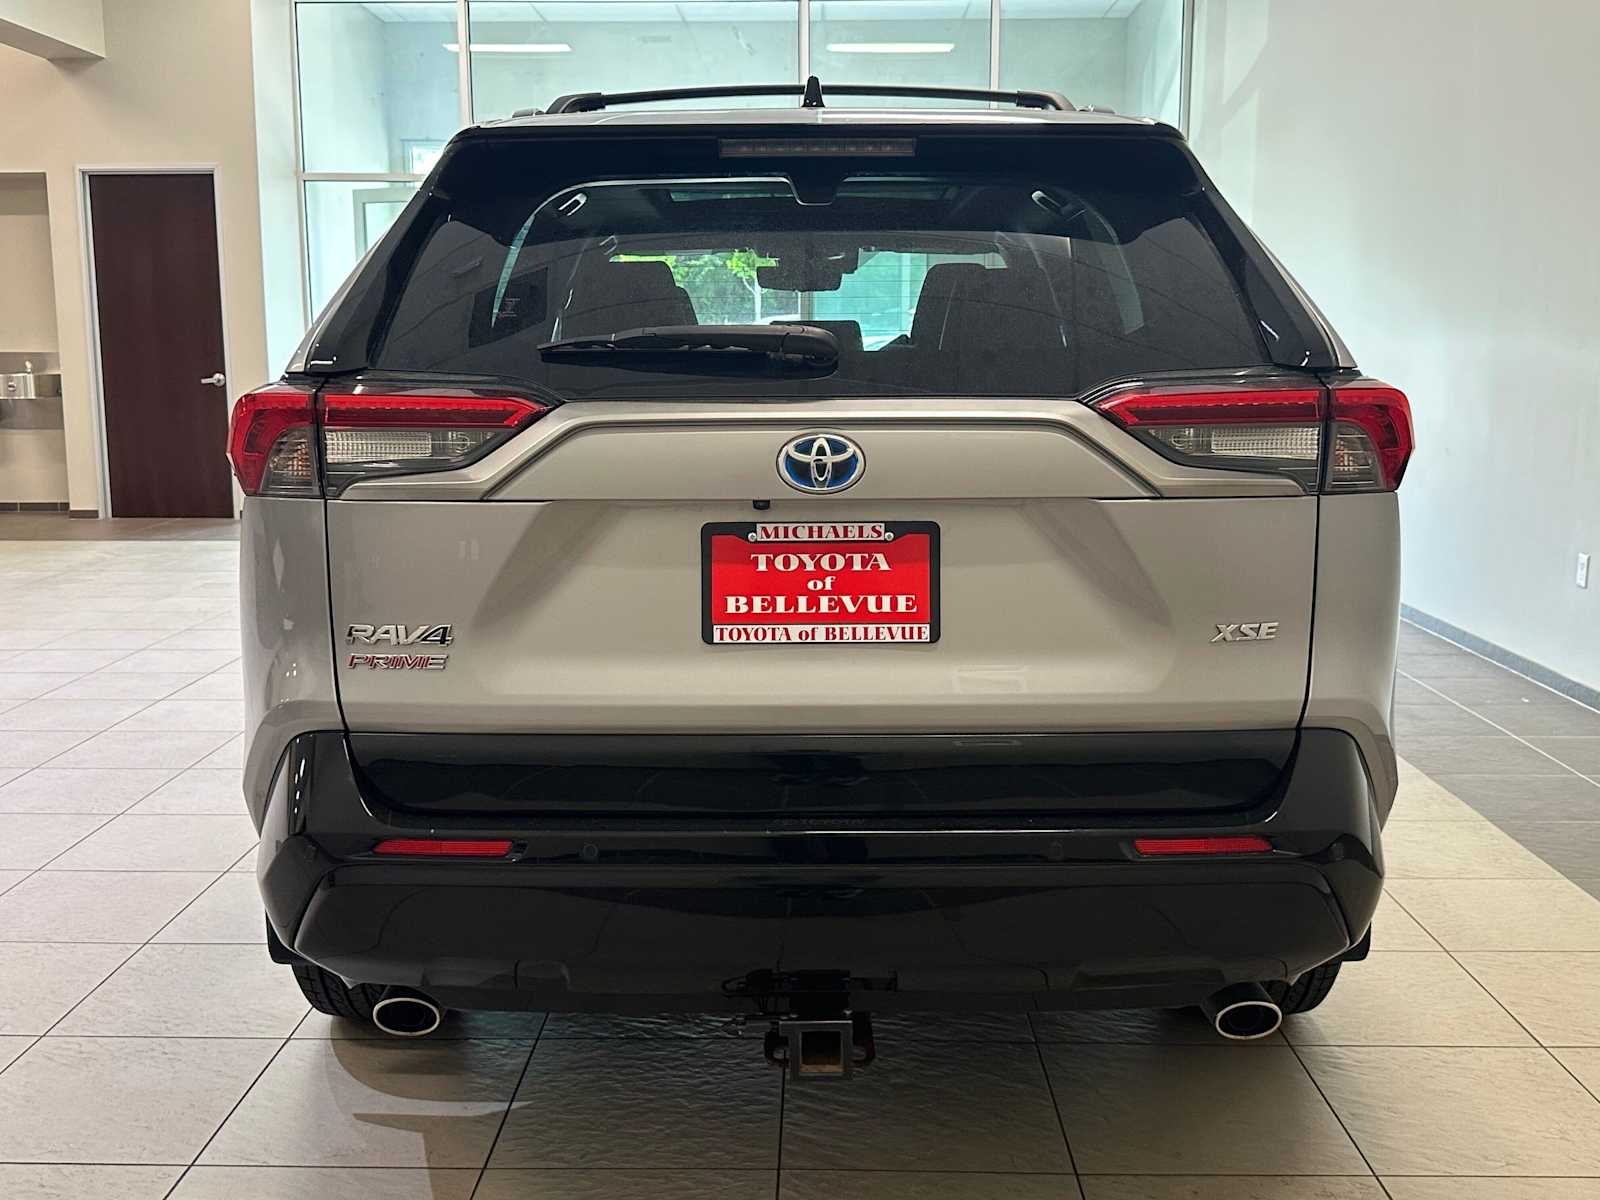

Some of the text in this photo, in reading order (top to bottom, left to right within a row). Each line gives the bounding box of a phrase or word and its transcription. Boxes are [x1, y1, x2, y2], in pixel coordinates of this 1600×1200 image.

[759, 525, 883, 539] MICHAELS
[751, 553, 891, 572] TOYOTA
[807, 576, 836, 591] of
[725, 595, 917, 614] BELLEVUE
[347, 624, 453, 646] RAV4
[716, 626, 928, 641] TOYOTA of BELLEVUE
[1211, 622, 1279, 642] XSE
[348, 653, 448, 668] PRIME
